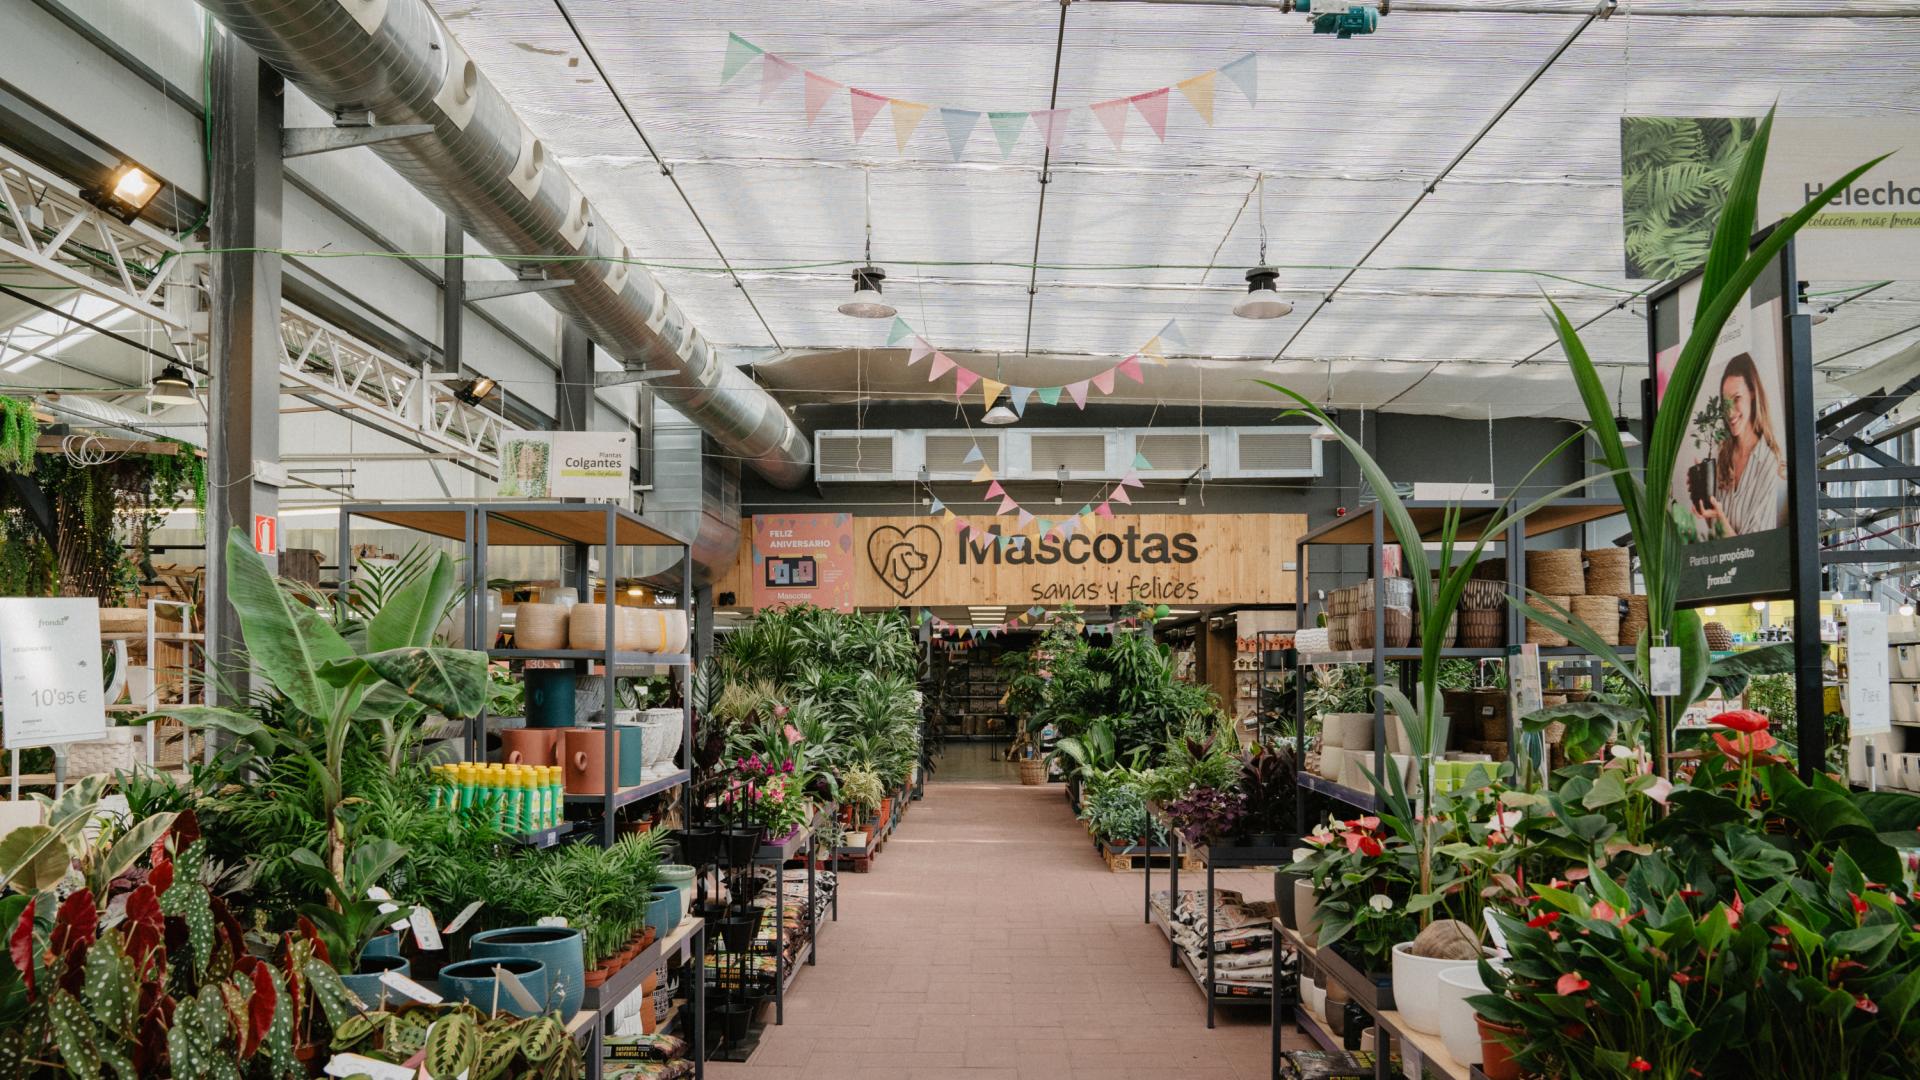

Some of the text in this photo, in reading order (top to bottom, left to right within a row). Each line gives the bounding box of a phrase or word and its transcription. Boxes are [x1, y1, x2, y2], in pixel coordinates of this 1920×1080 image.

[1861, 216, 1888, 227] más
[565, 457, 622, 470] Colgantes
[769, 530, 793, 538] FELIZ
[769, 539, 832, 549] ANIVERSARIO
[958, 524, 1199, 565] Mascotas
[1719, 547, 1755, 565] propósito
[1031, 574, 1200, 602] sanas y felices
[777, 592, 812, 600] Mascotas
